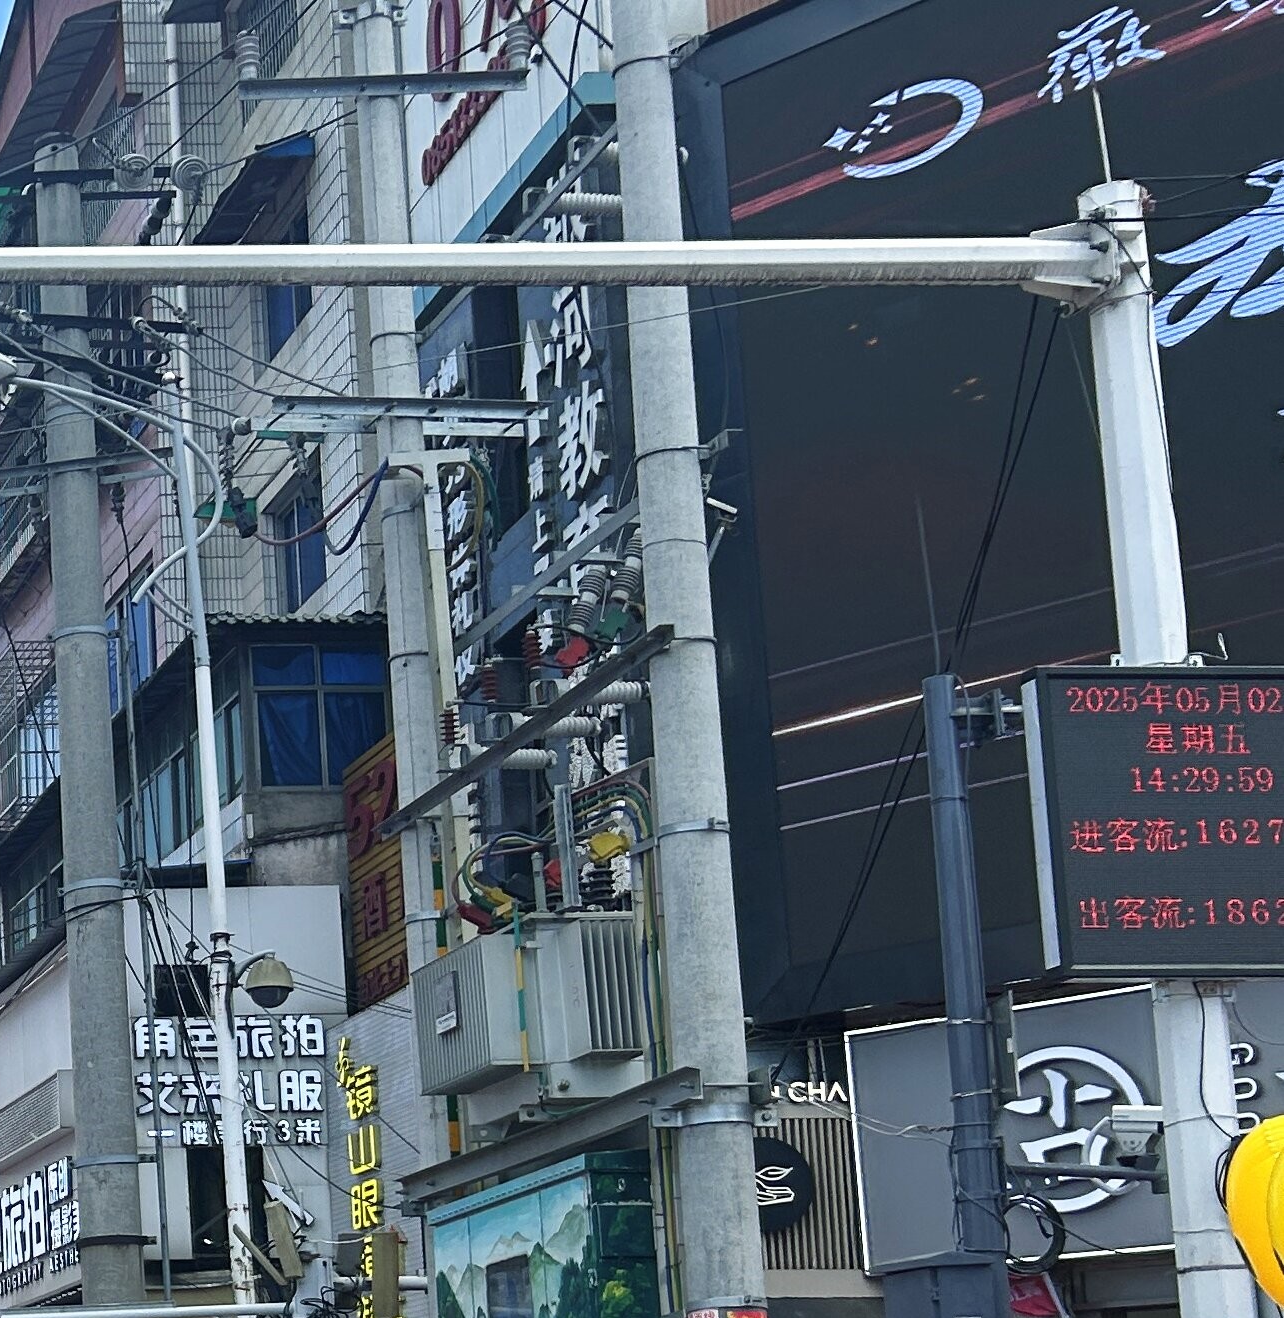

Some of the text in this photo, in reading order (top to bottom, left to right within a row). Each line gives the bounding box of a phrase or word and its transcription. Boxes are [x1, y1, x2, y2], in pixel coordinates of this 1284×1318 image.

[1145, 723, 1251, 754] 星期五
[1131, 767, 1274, 792] 14:29:59
[147, 1118, 321, 1145] 一楼行3米
